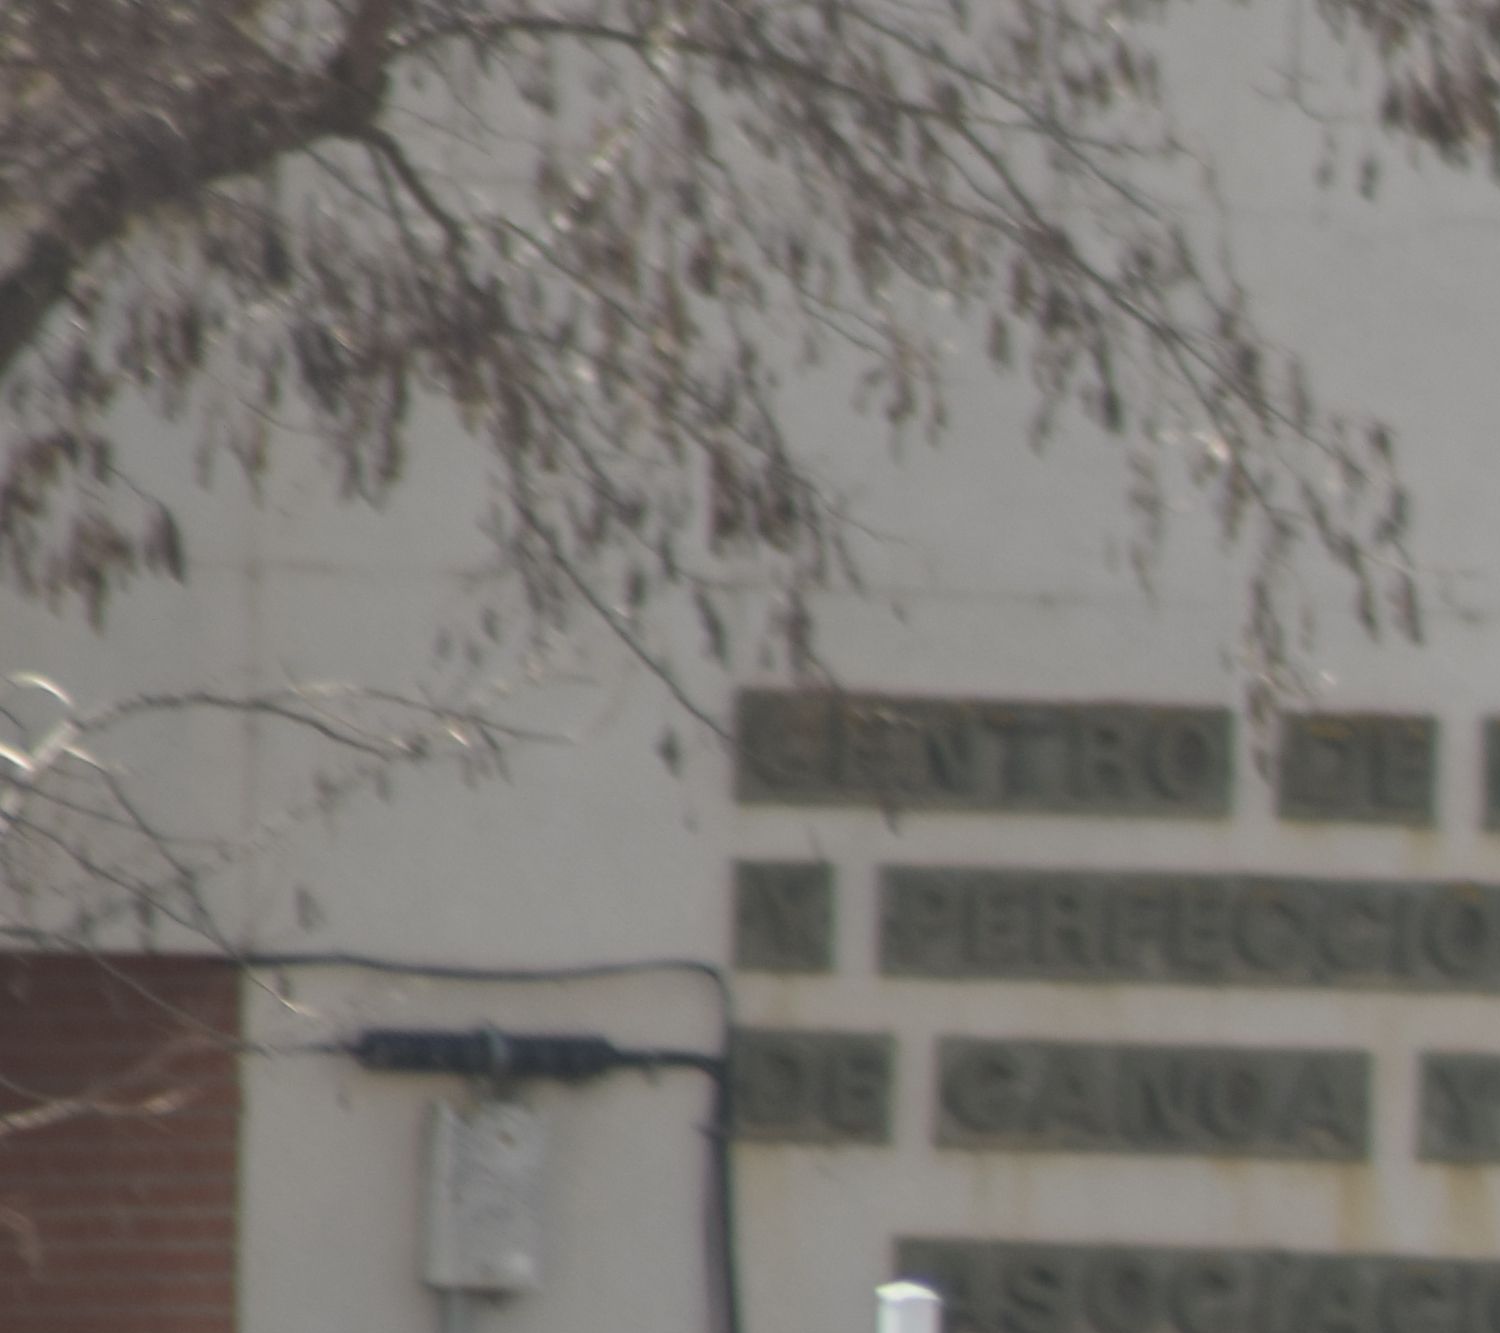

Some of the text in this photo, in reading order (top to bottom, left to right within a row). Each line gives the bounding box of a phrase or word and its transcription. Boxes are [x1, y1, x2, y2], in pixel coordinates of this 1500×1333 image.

[745, 700, 1226, 804] CENTRO
[1284, 716, 1432, 814] DE
[743, 866, 826, 964] Y
[738, 1036, 890, 1136] DE
[942, 1044, 1362, 1148] CANOA
